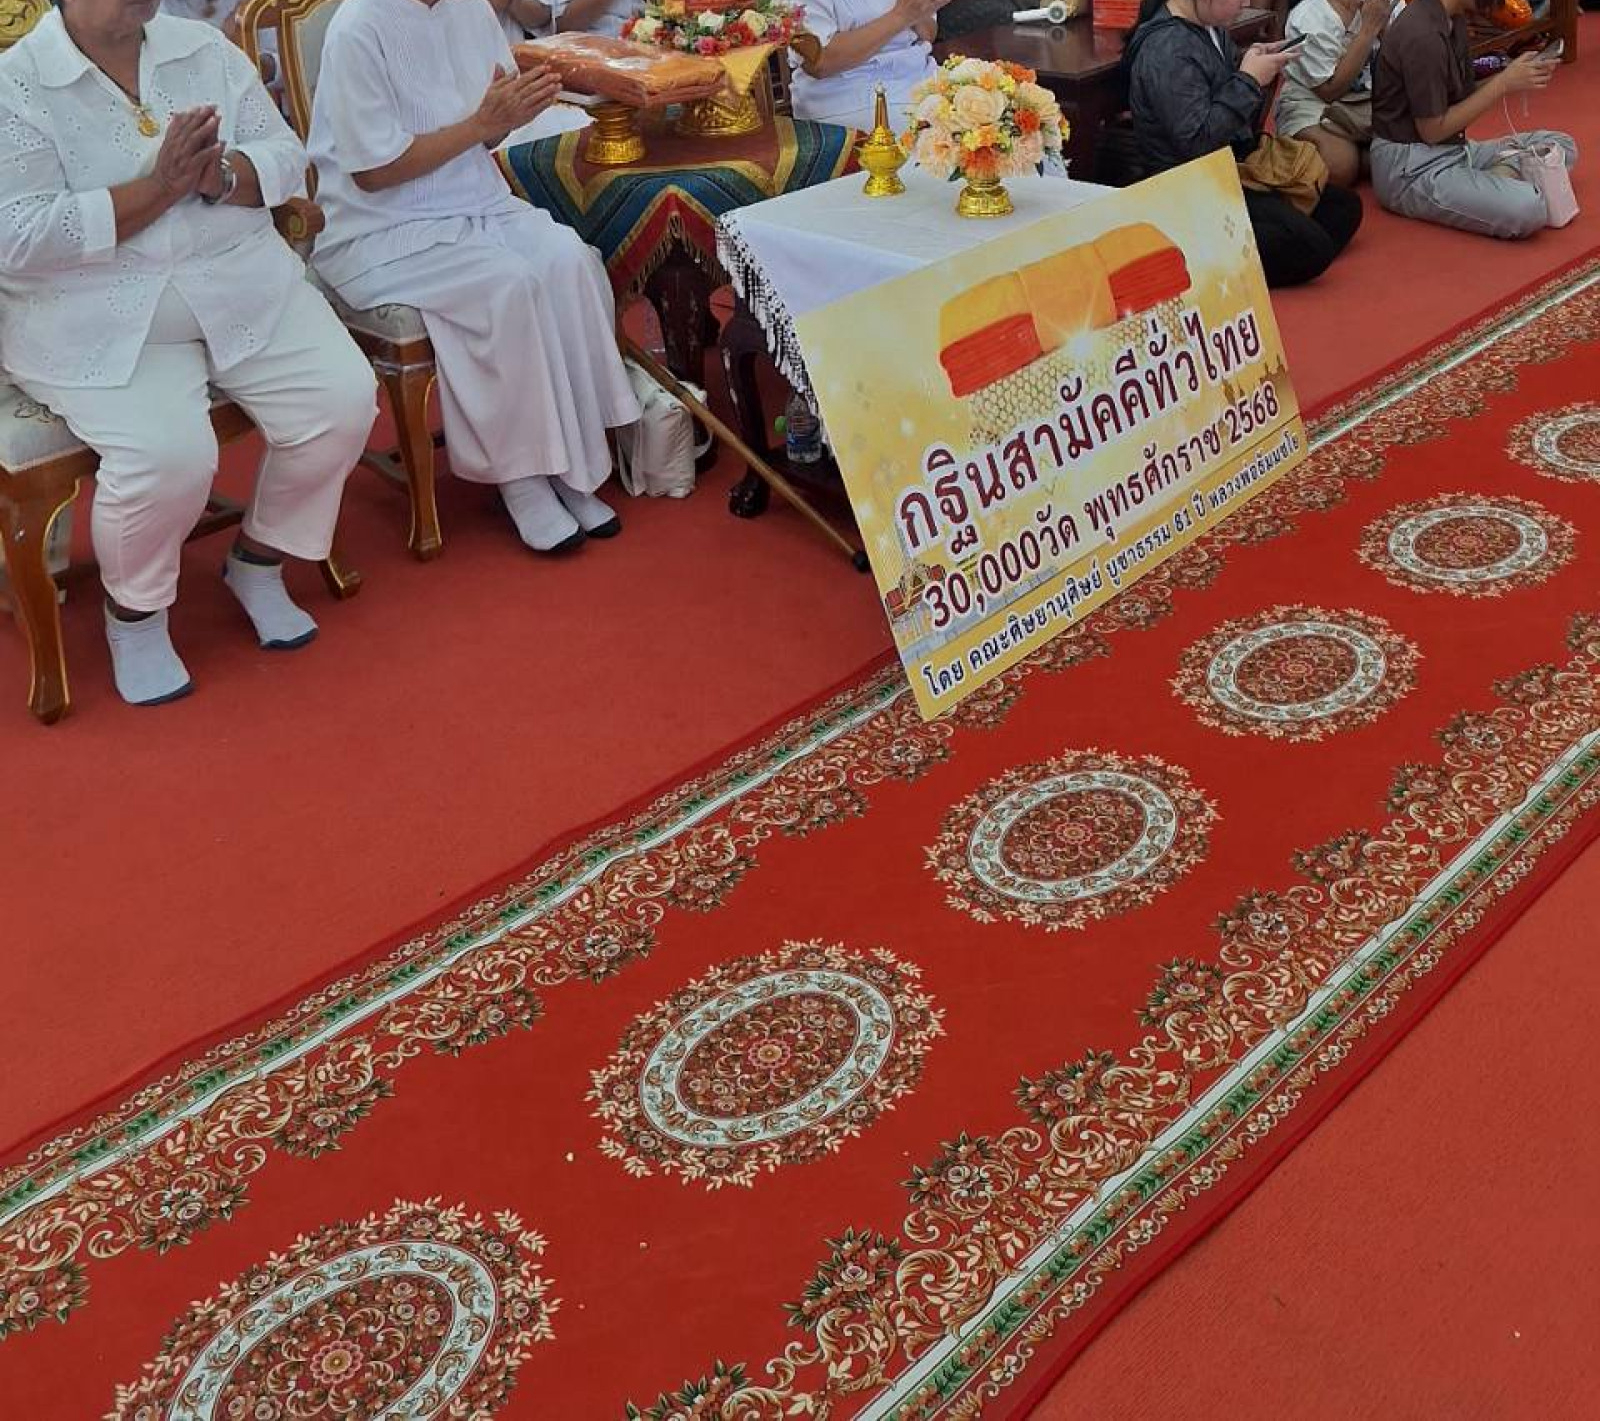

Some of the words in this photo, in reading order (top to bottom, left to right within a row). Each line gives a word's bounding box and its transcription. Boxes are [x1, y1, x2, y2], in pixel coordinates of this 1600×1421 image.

[898, 310, 1261, 555] กฐินสามัคคีทั่วไทย
[924, 504, 1081, 629] 30,000วัด
[1084, 423, 1222, 542] พุทธศักราช
[1224, 382, 1279, 445] 2568
[923, 659, 965, 697] โดย
[968, 559, 1103, 671] คณะศิษยานุศิษย์
[1105, 524, 1172, 588] บูชาธรรม
[1173, 510, 1194, 532] 81
[1192, 492, 1207, 519] ปี
